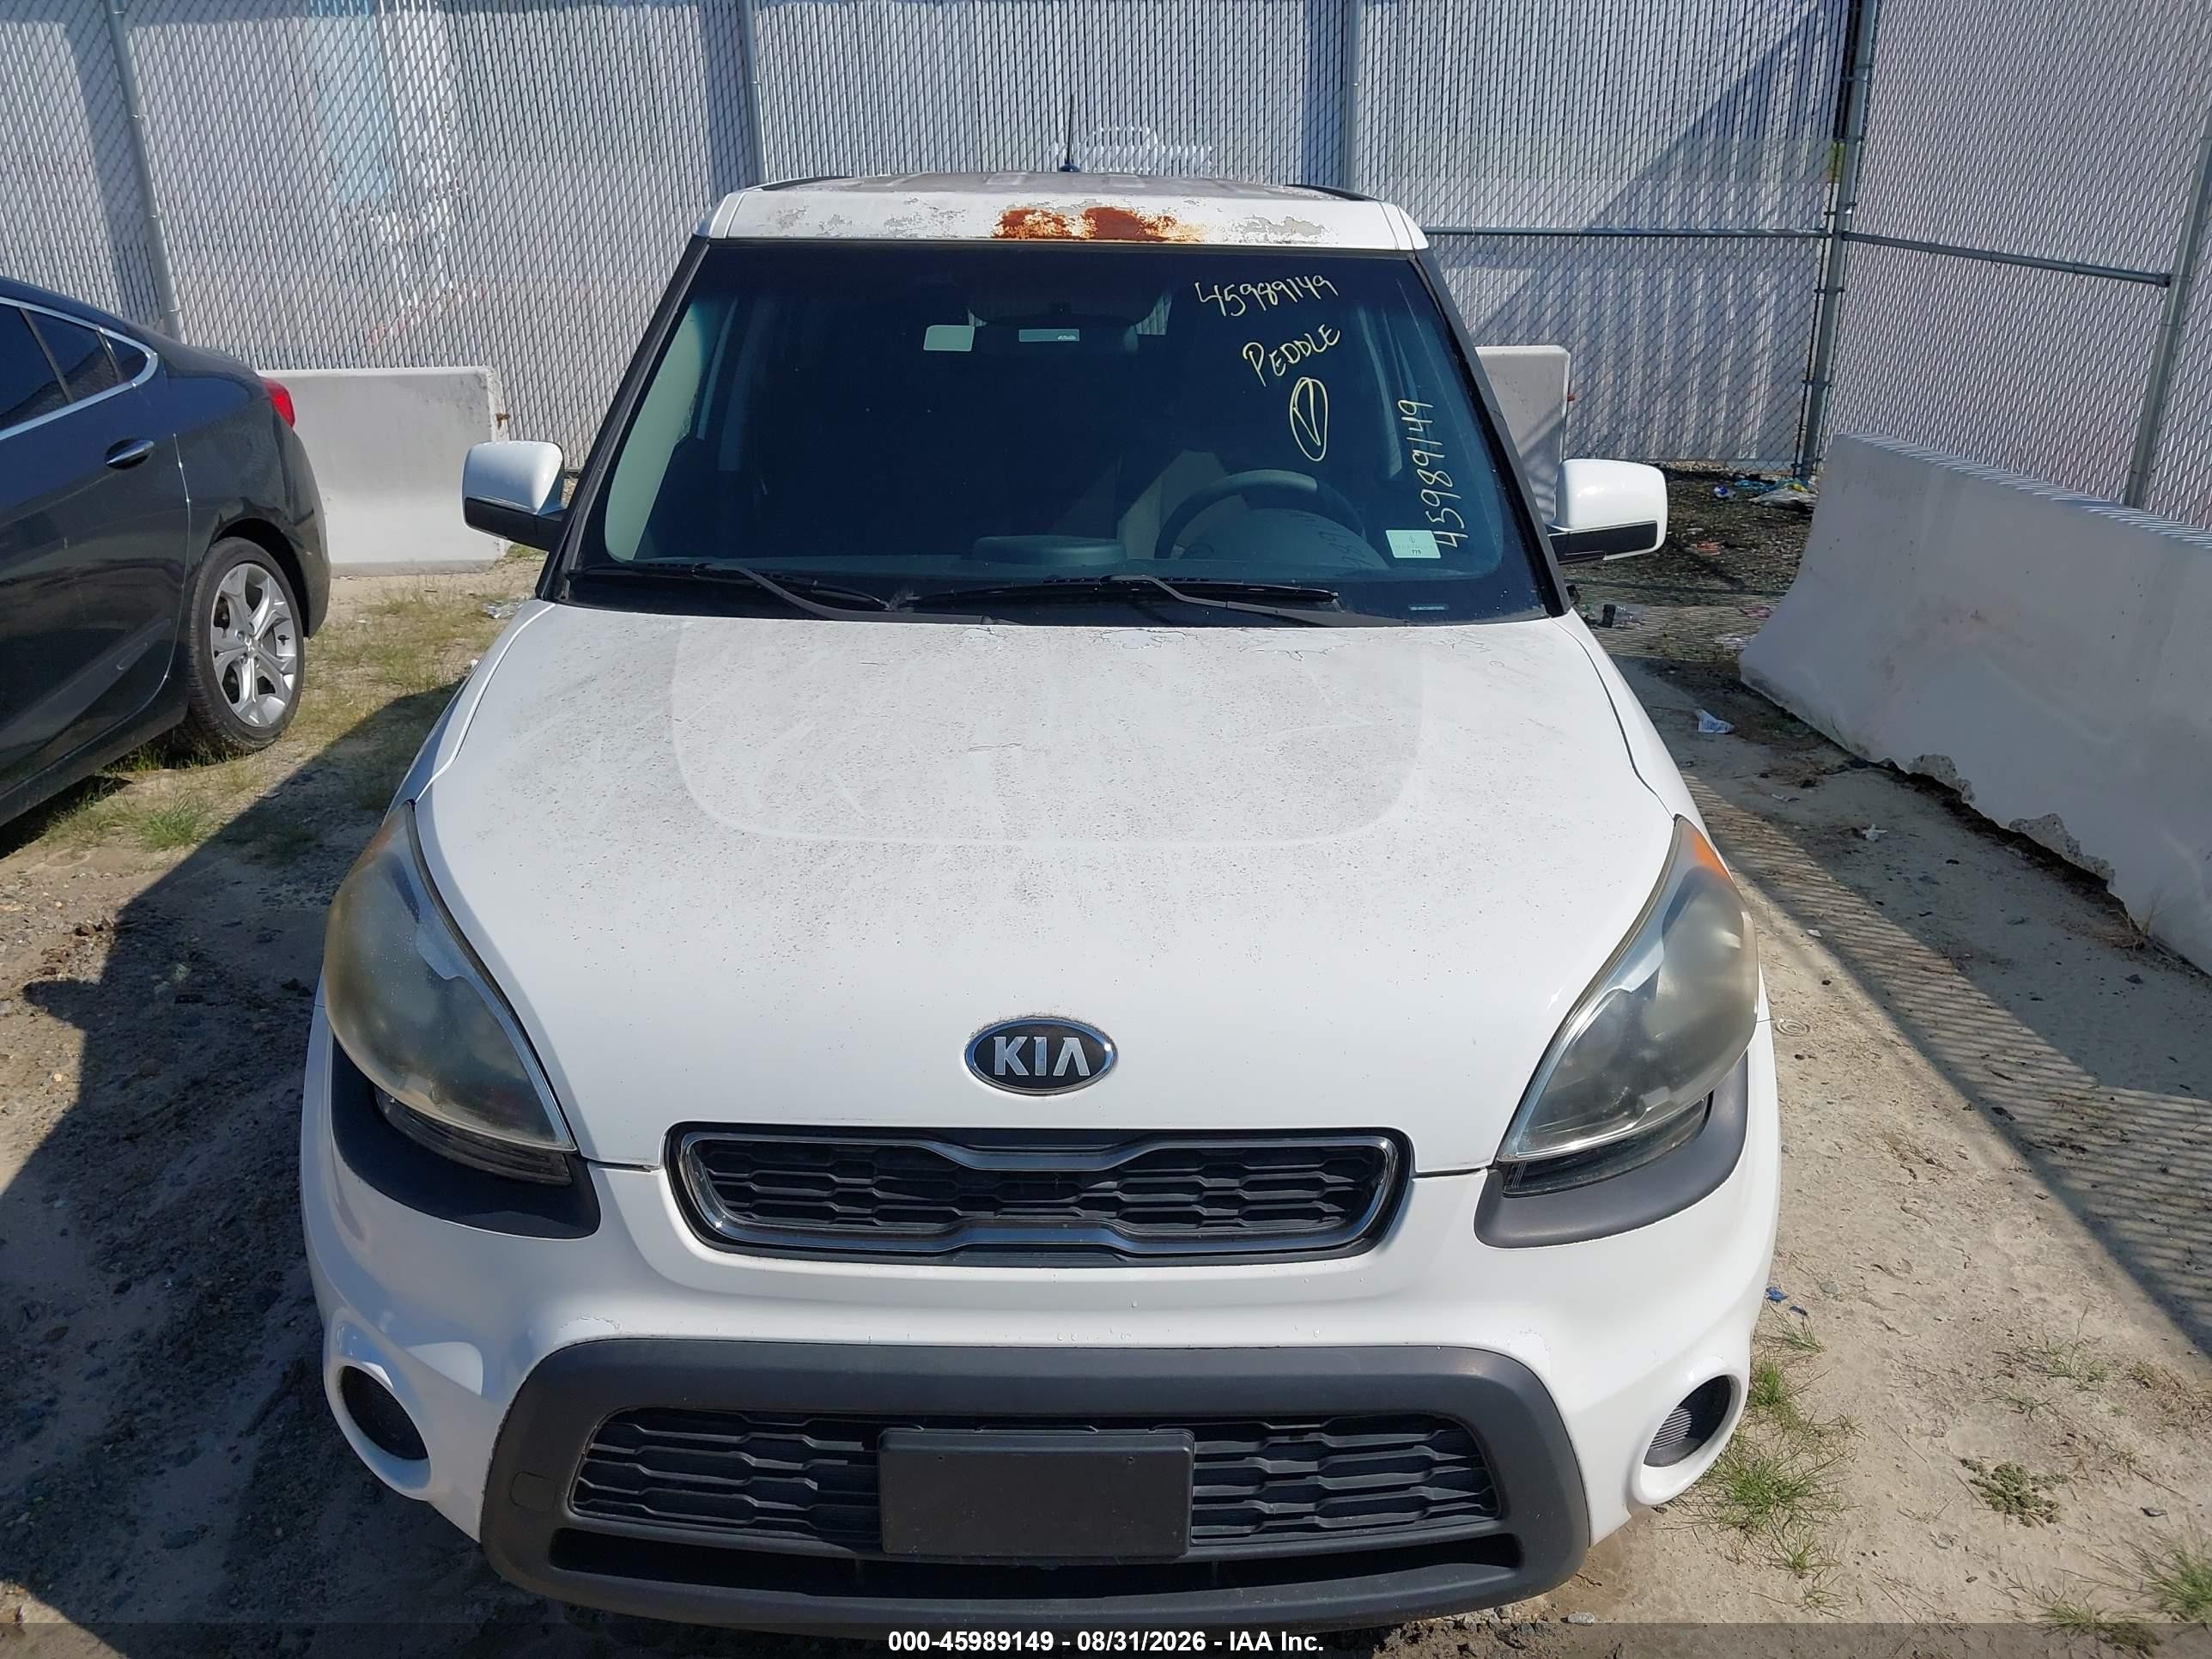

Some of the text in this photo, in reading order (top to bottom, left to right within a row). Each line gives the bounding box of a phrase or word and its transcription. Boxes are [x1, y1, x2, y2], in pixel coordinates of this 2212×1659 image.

[1195, 275, 1339, 317] 45989149
[1243, 324, 1340, 386] PEDDLE
[1398, 399, 1468, 548] 45989149
[994, 1036, 1091, 1076] KIA
